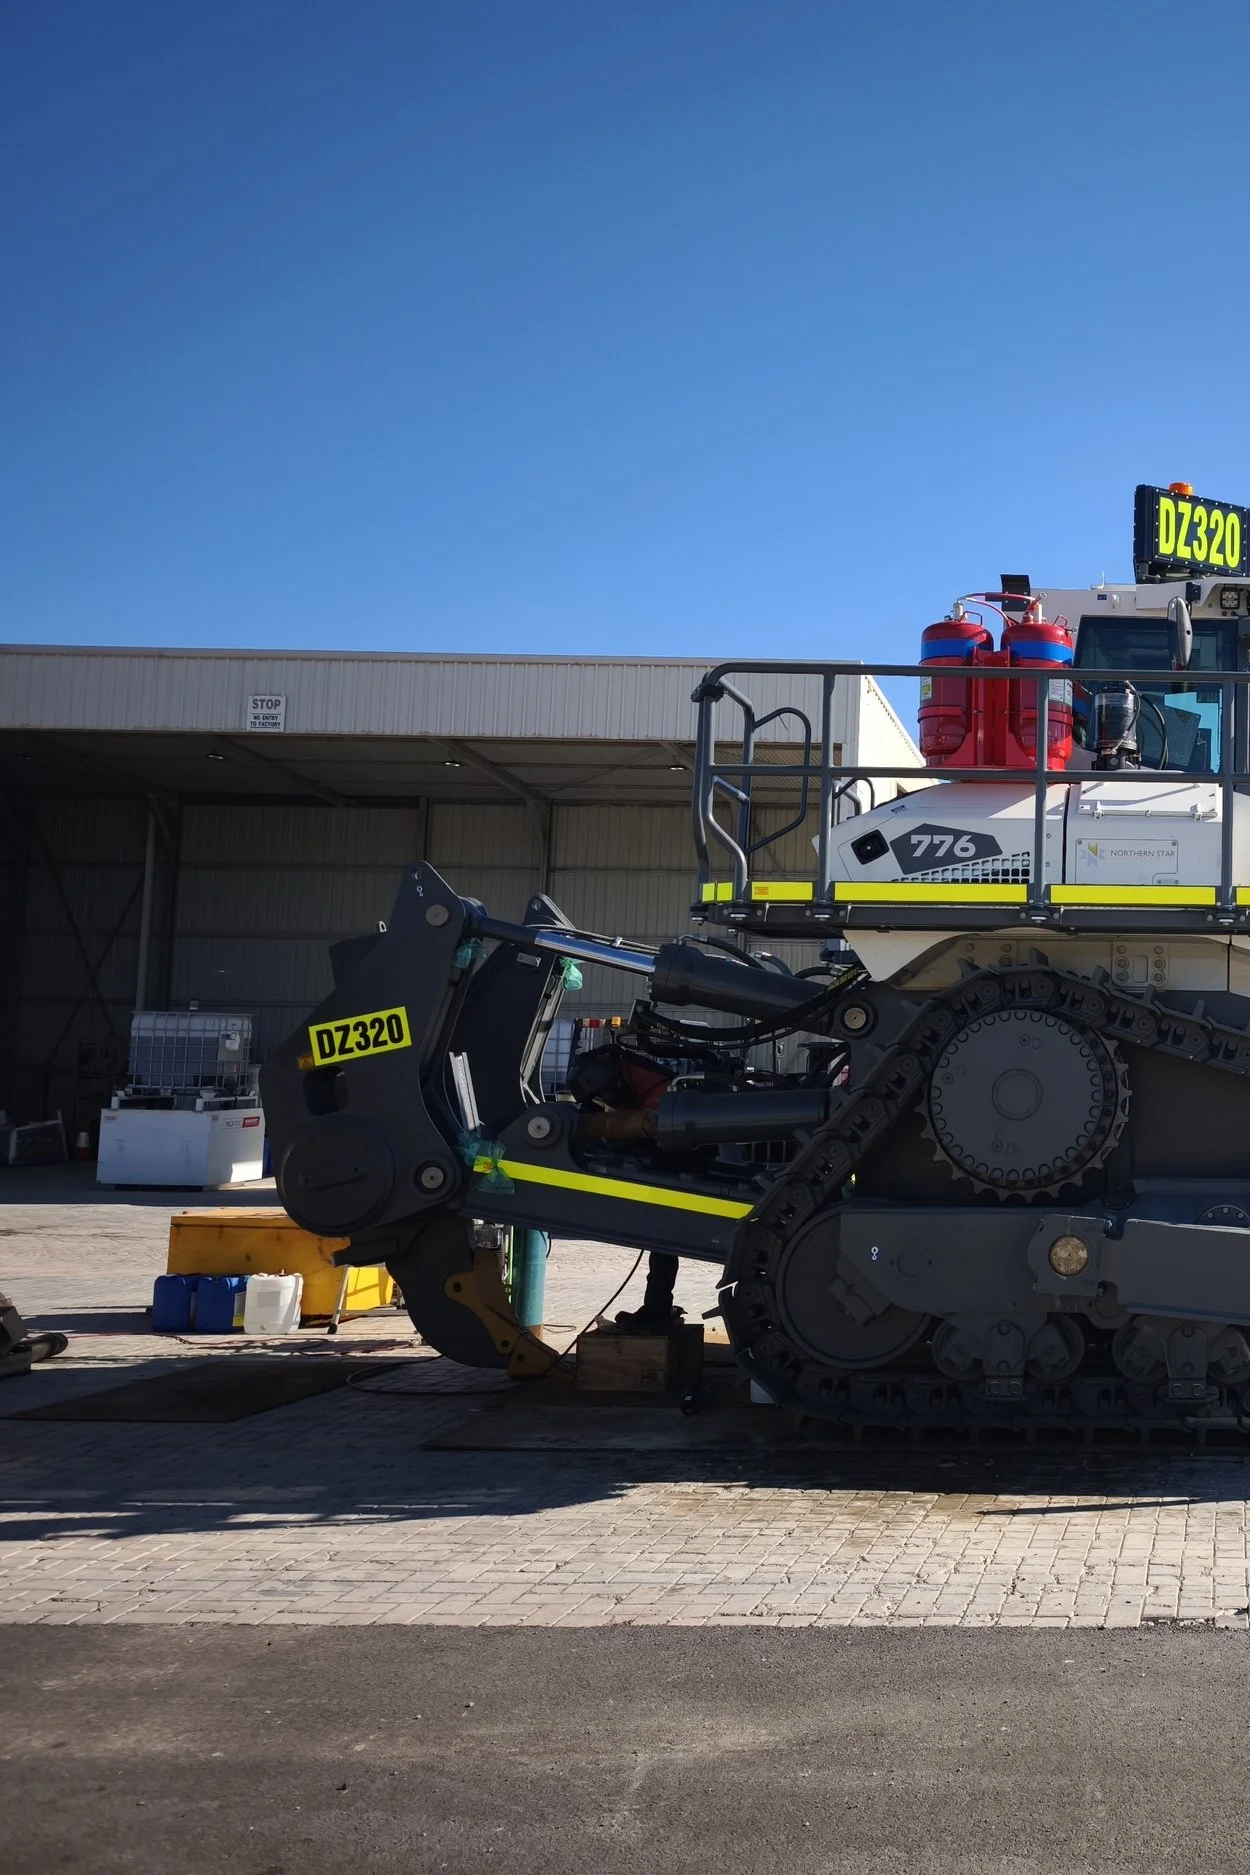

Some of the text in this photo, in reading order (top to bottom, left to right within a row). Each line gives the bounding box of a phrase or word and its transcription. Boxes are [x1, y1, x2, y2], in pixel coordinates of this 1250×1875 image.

[1159, 496, 1240, 568] DZ320
[252, 698, 281, 710] STOP
[911, 834, 976, 858] 776
[1110, 849, 1155, 857] NORTHERN
[315, 1013, 405, 1060] DZ320
